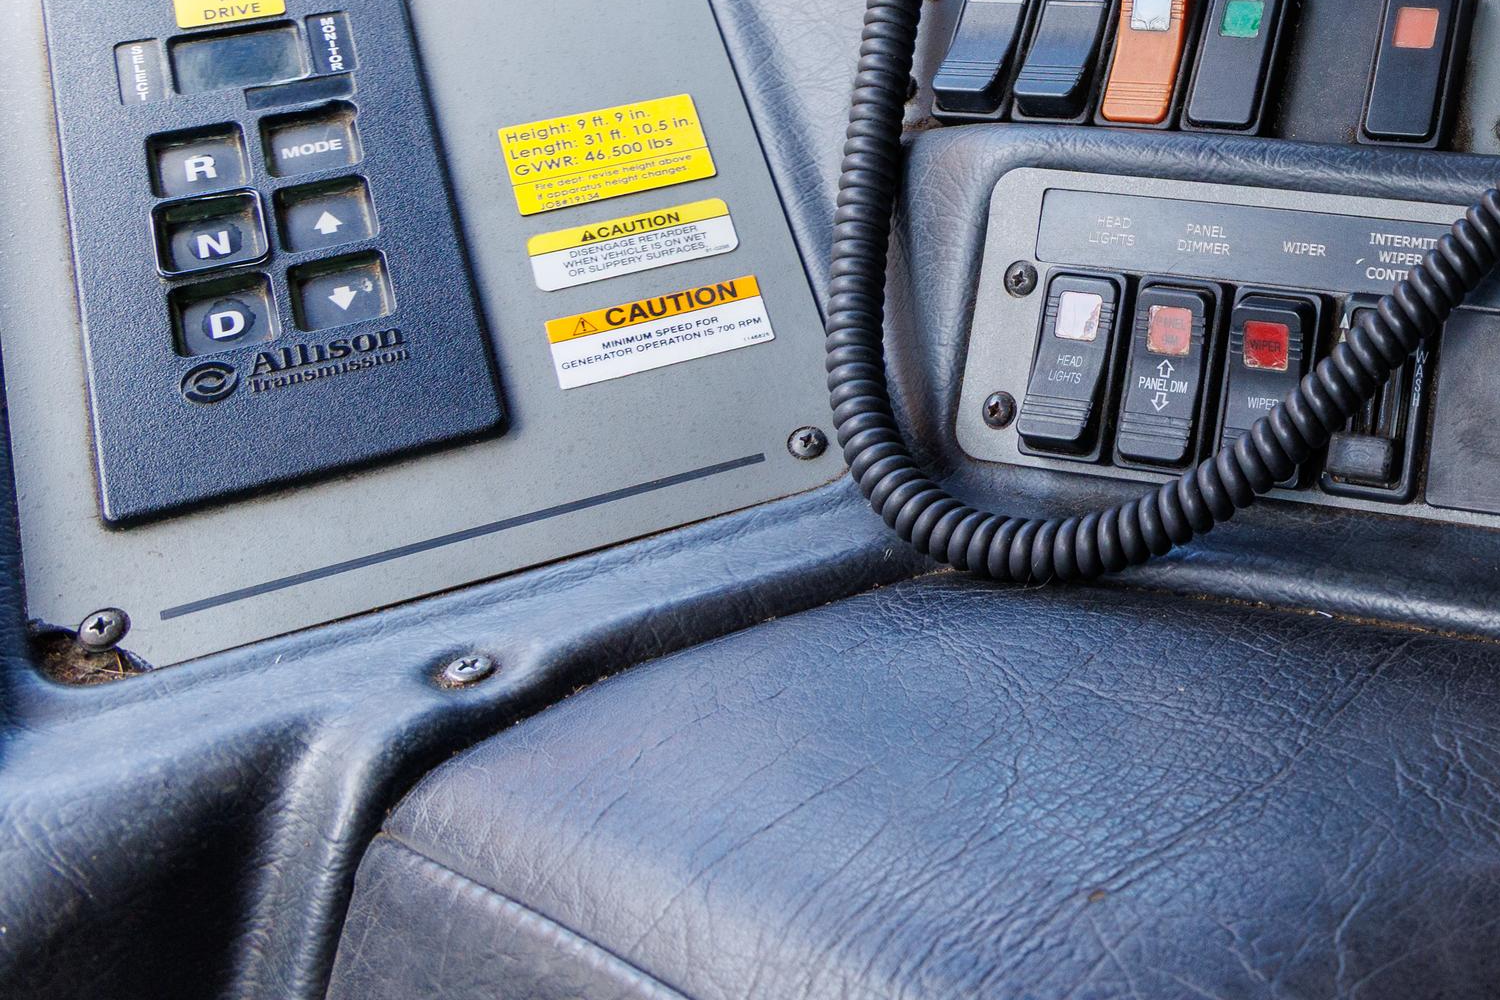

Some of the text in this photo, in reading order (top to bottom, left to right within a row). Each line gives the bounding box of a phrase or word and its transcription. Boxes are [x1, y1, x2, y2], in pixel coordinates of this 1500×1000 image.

[203, 2, 261, 20] DRIVE
[319, 16, 344, 72] MONITOR
[131, 45, 149, 101] SELECT
[506, 109, 651, 144] Height: 9 ft. 9 in.
[510, 116, 694, 160] Length: 31 ft. 10.5 in.
[281, 138, 343, 160] MODE
[514, 154, 580, 176] GVWR:
[647, 136, 674, 151] lbs
[184, 154, 217, 183] R
[535, 181, 554, 191] Fire
[588, 168, 619, 181] revise
[622, 160, 655, 174] height
[658, 154, 692, 167] above
[547, 182, 602, 200] apparatus
[605, 173, 638, 188] height
[596, 211, 681, 239] CAUTION
[1096, 215, 1133, 229] HEAD
[1186, 224, 1227, 239] PANEL
[196, 230, 231, 259] N
[563, 232, 708, 270] WHEN VEHICLE IS ON WET
[569, 224, 698, 259] DISENGAGE RETARDER
[1088, 231, 1136, 247] LIGHTS
[1176, 239, 1231, 256] DIMMER
[1282, 241, 1327, 257] WIPER
[568, 268, 586, 278] OR
[588, 256, 643, 274] SLIPPERY
[1378, 250, 1424, 266] WIPER
[604, 281, 738, 327] CAUTION
[209, 310, 245, 340] D
[601, 316, 719, 350] MINIMUM SPEED FOR
[250, 326, 406, 377] Allison
[561, 317, 762, 371] GENERATOR OPERATION IS 700 RPM
[1250, 341, 1282, 353] WIPER
[249, 350, 410, 393] Transmission
[1056, 354, 1083, 368] HEAD
[1048, 371, 1082, 384] LIGHTS
[1138, 376, 1189, 394] PANEL DIM
[1412, 349, 1429, 407] WASH
